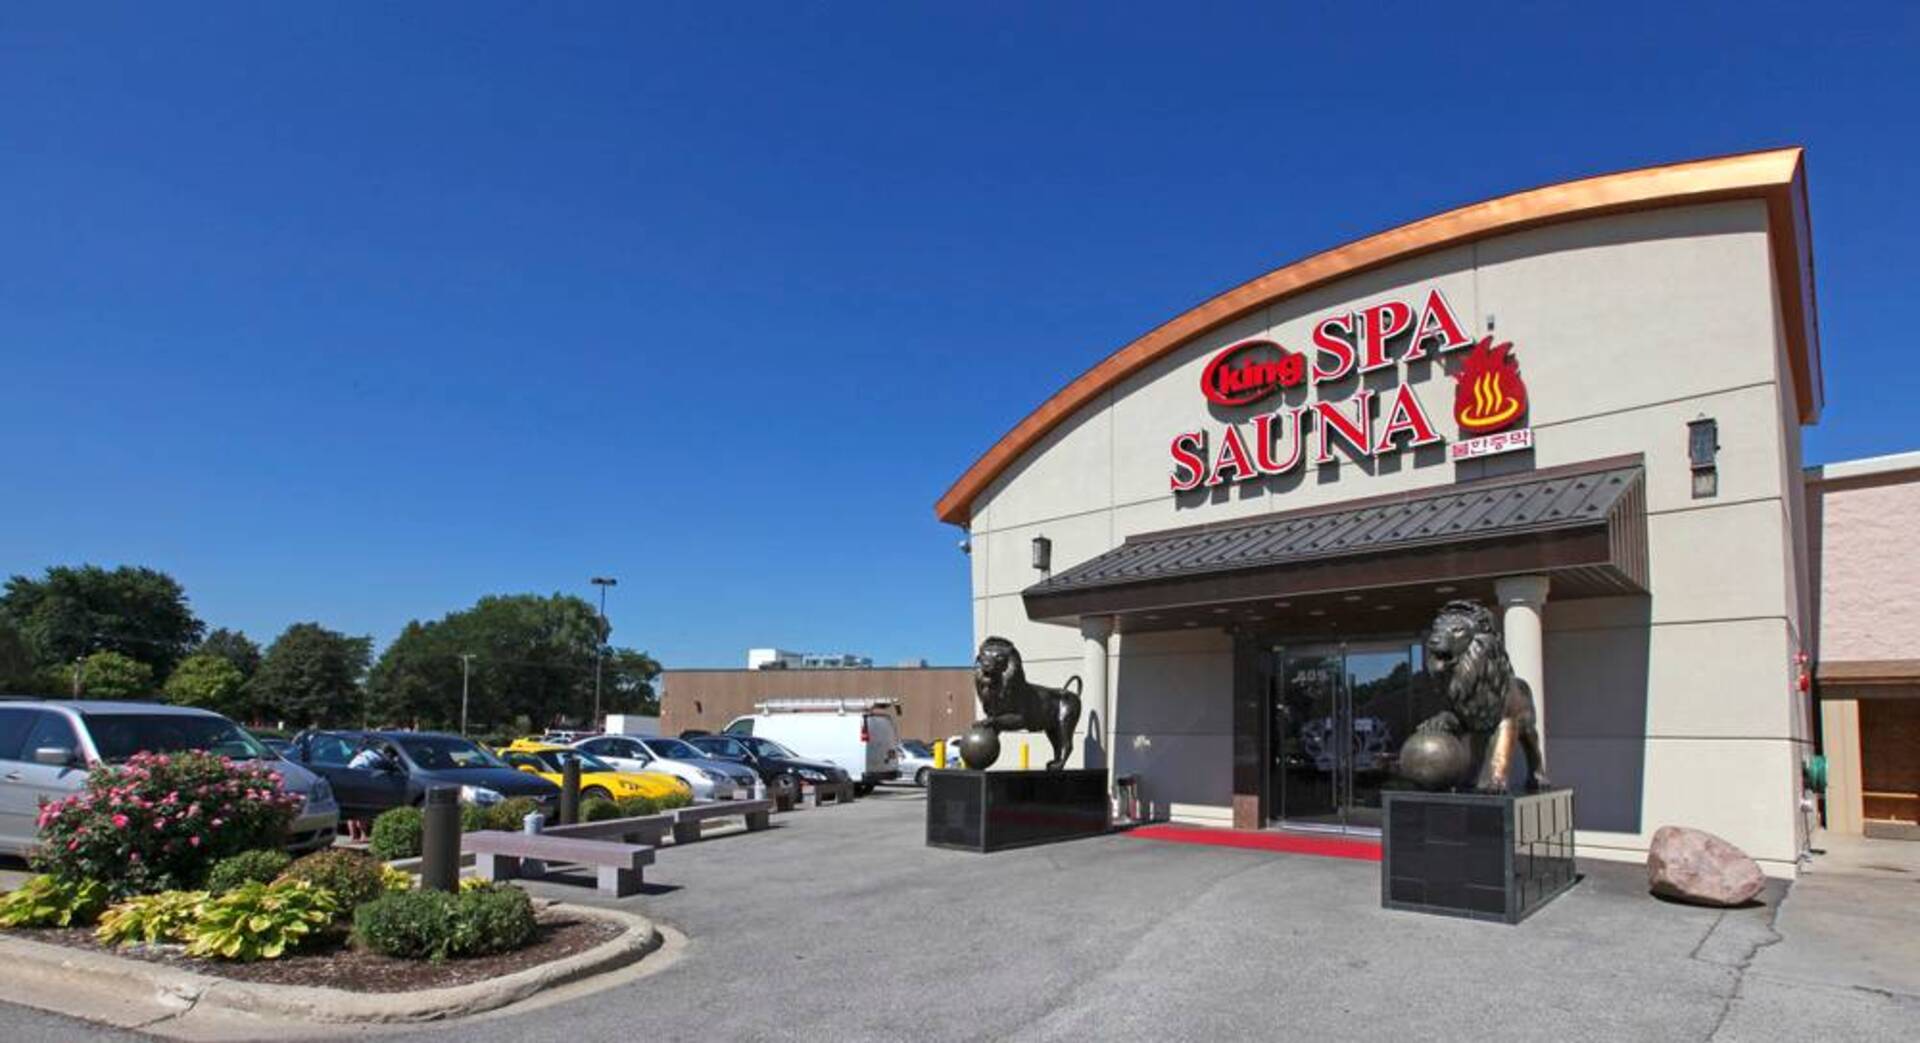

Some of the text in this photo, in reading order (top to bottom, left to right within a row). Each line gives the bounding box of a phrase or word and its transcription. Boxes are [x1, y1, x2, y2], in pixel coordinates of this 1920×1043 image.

[1216, 289, 1472, 397] king SPA
[1170, 385, 1439, 492] SAUNA
